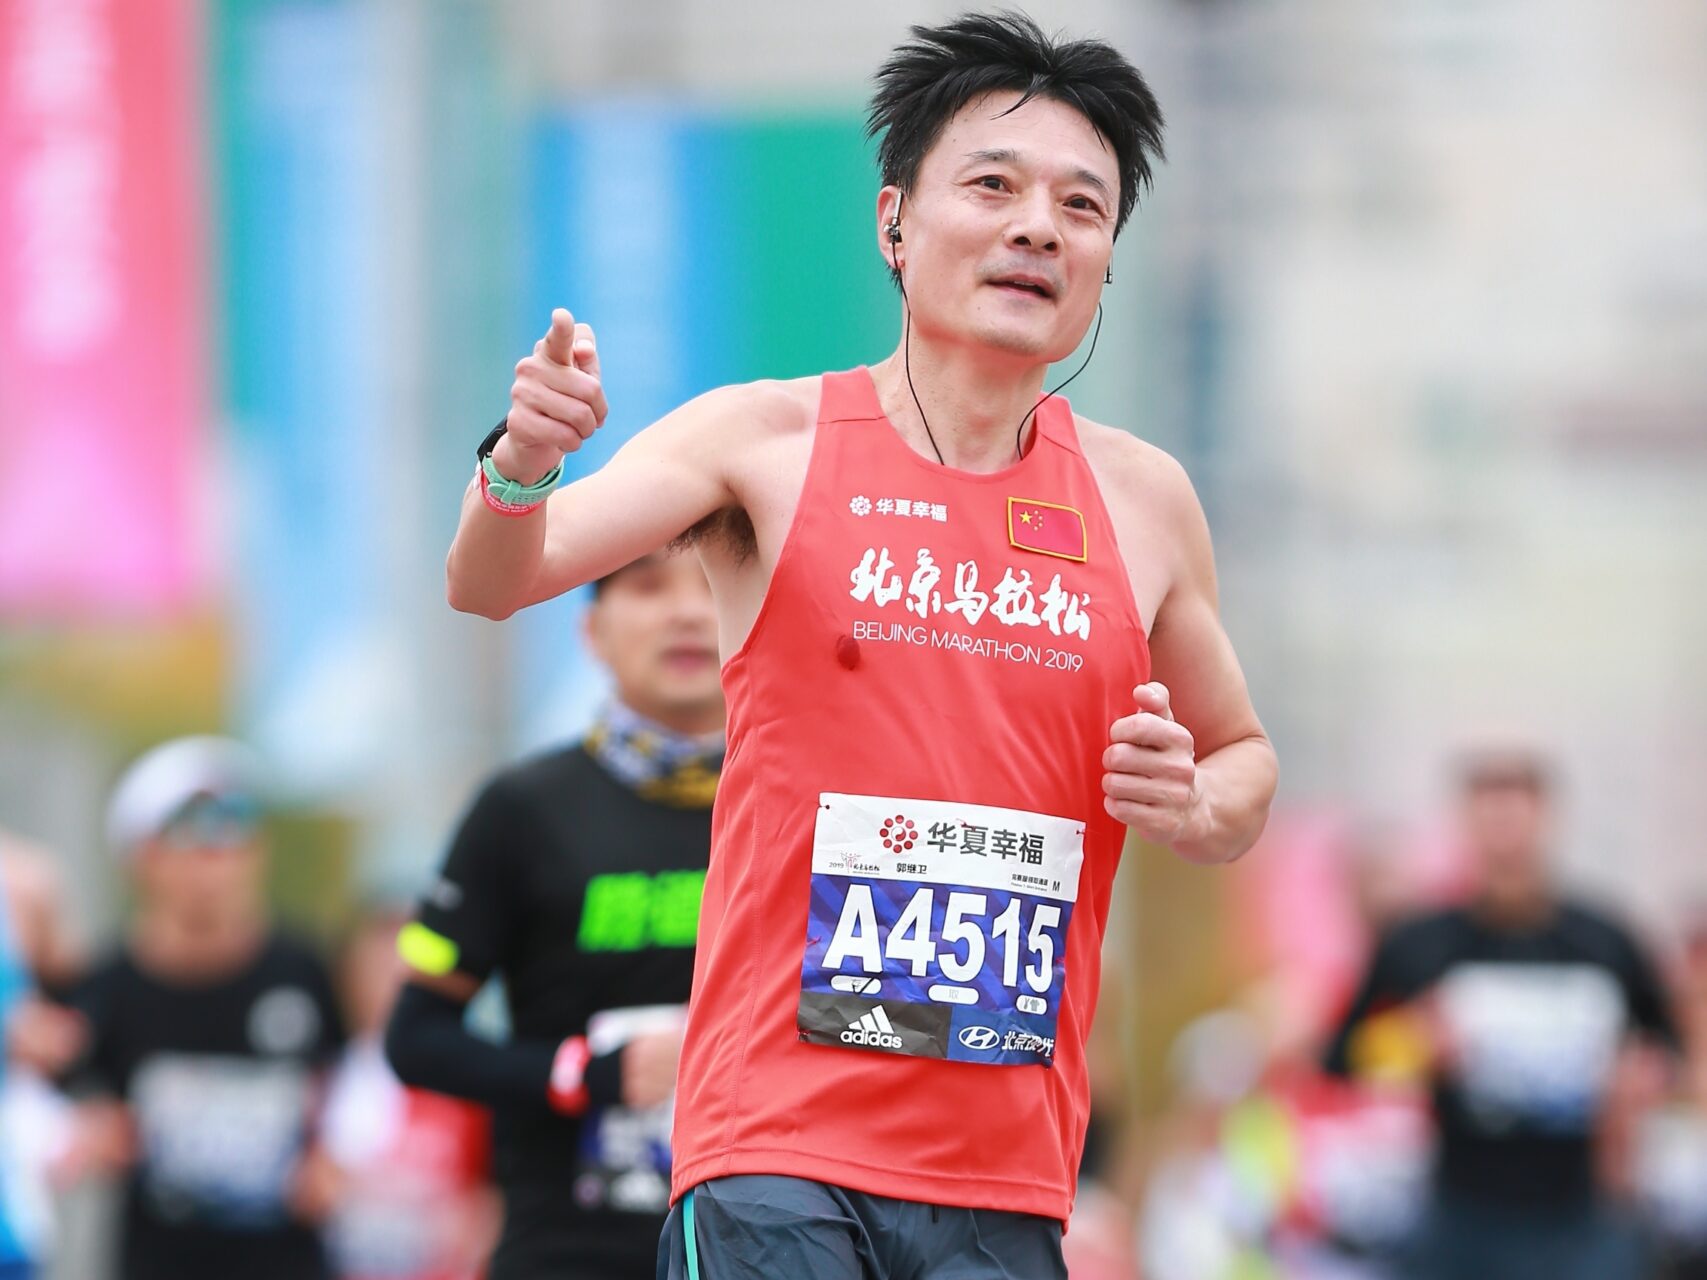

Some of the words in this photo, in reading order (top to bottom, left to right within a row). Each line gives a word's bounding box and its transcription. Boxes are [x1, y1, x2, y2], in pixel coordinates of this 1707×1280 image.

[876, 498, 948, 522] 华夏幸福
[849, 547, 1092, 641] 北京马拉松
[853, 620, 928, 645] BEIJING
[931, 631, 1041, 665] MARATHON
[1045, 648, 1084, 673] 2019
[927, 821, 1045, 866] 华夏幸福
[1052, 880, 1061, 892] M
[821, 883, 1062, 994] A4515
[840, 1029, 903, 1049] adidas
